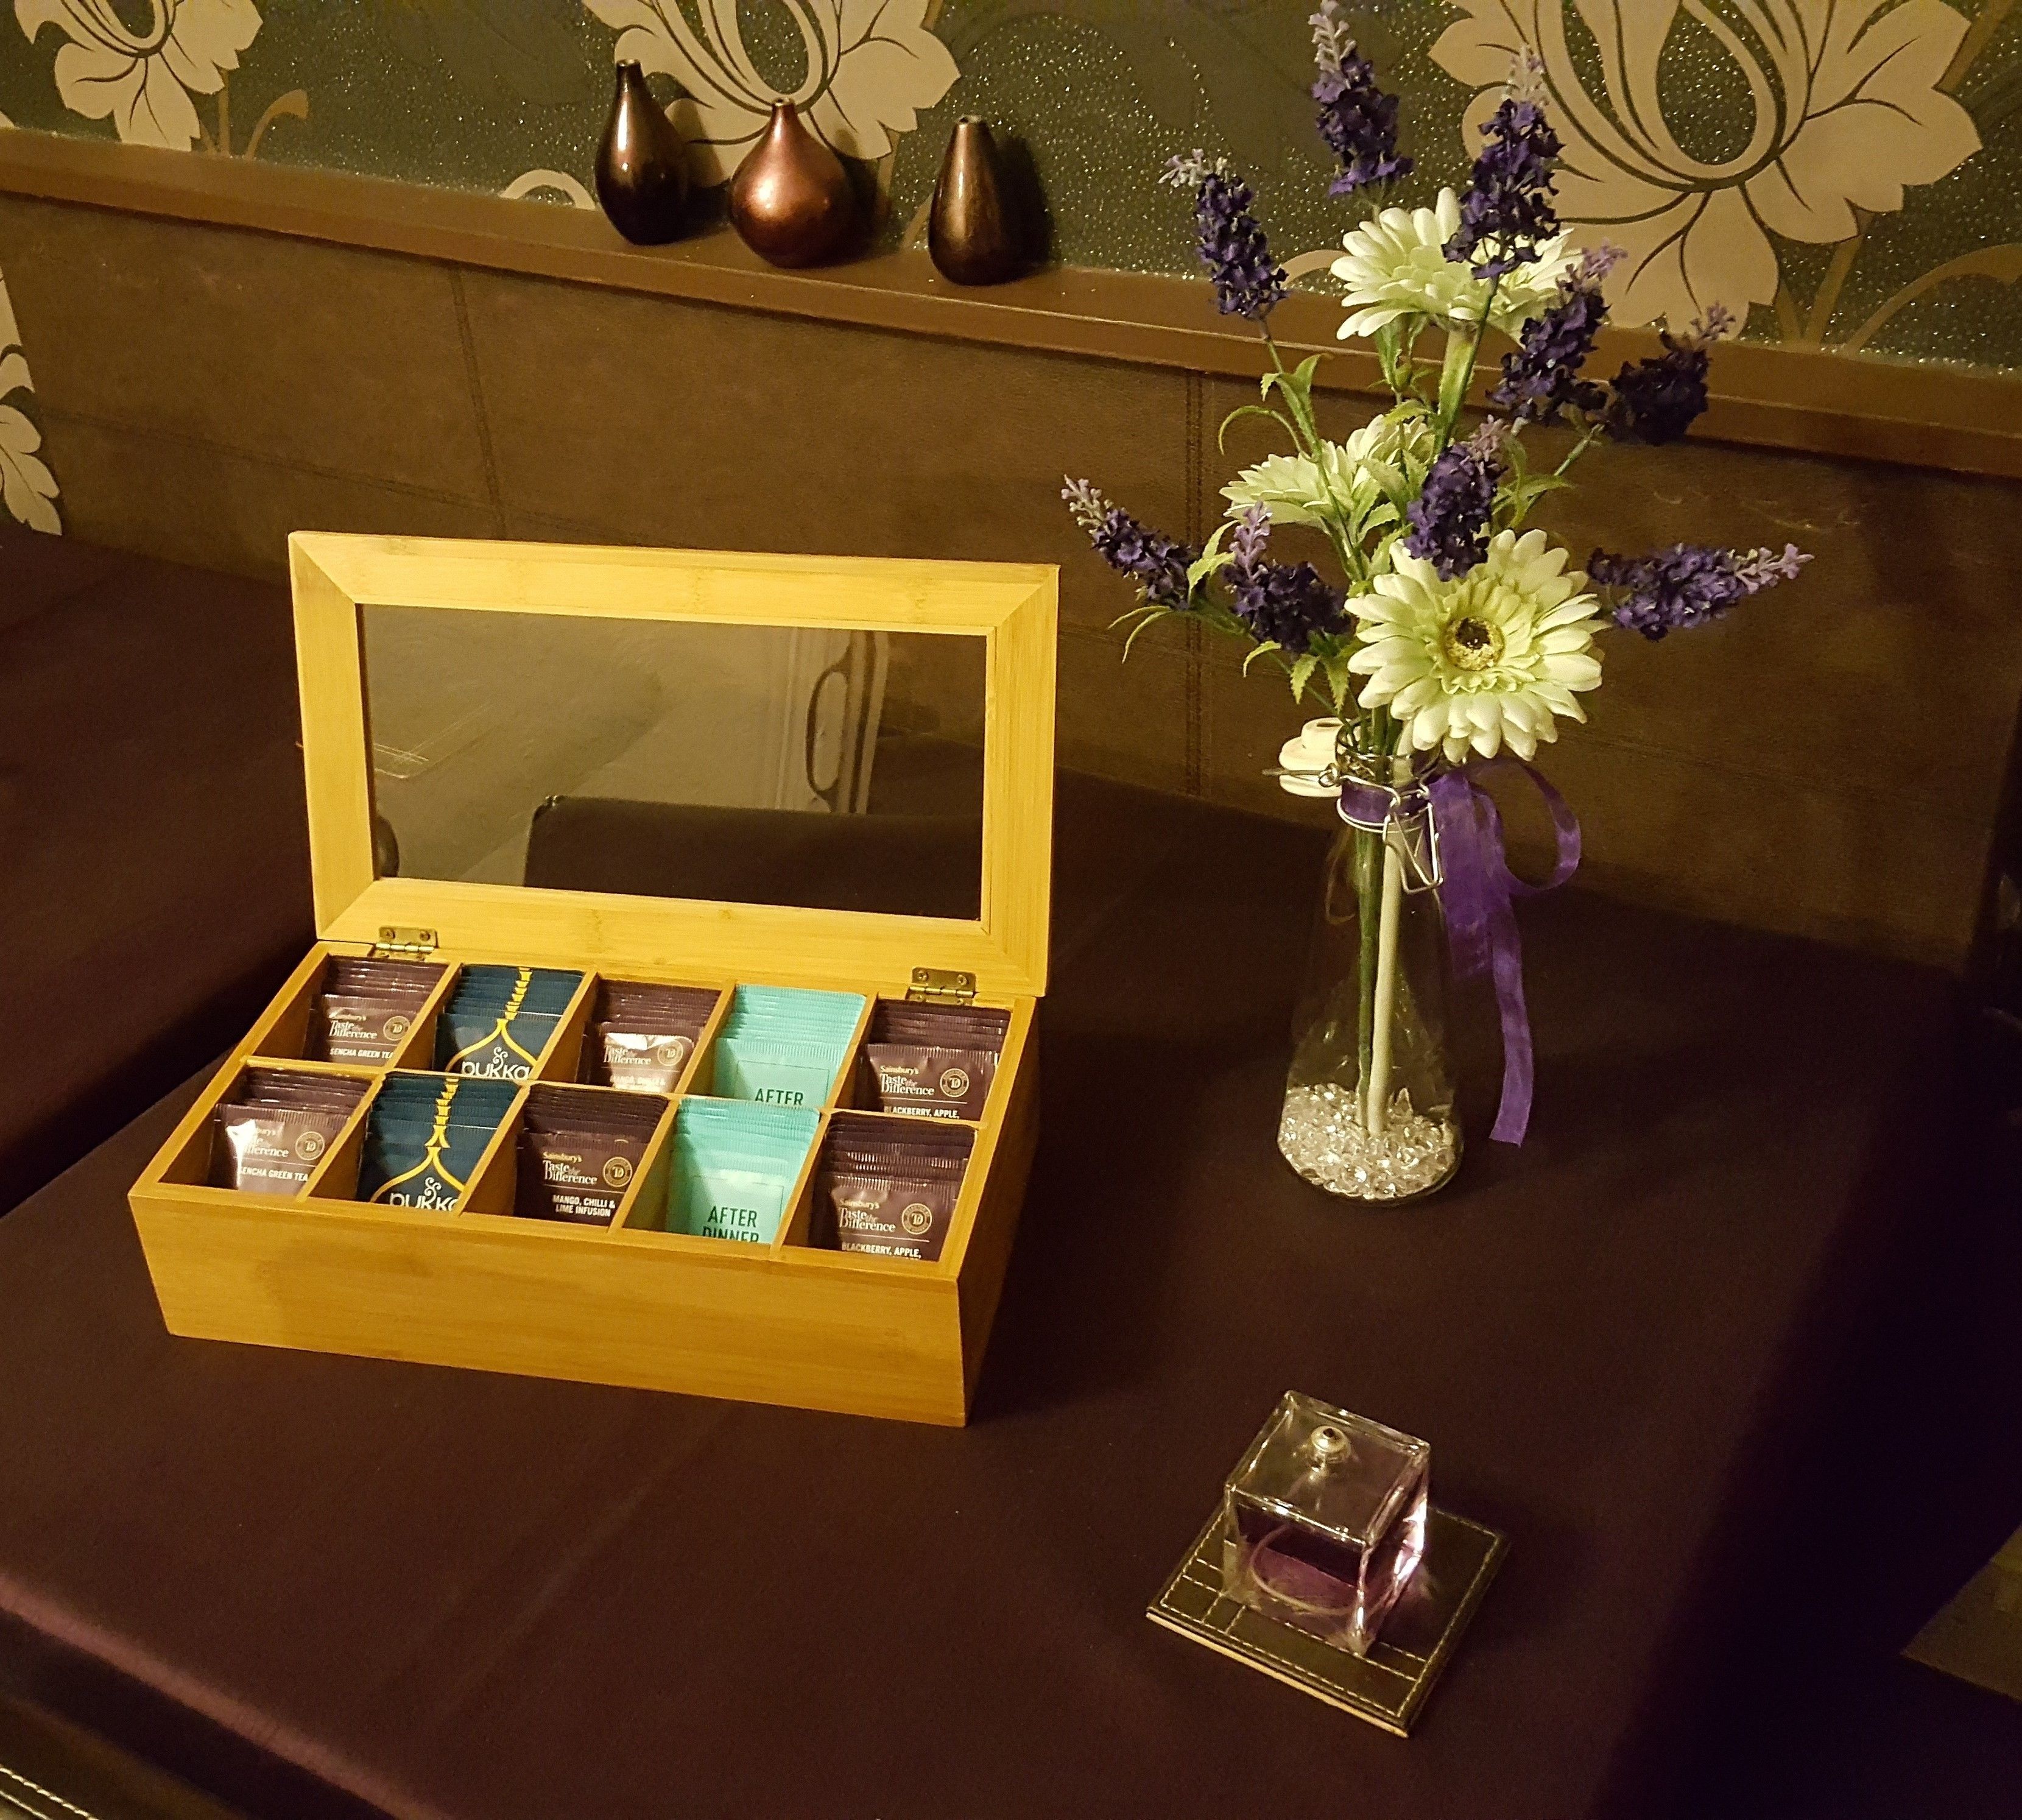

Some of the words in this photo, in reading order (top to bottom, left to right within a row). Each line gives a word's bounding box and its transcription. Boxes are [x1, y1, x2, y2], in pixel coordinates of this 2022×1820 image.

[329, 1027, 378, 1039] Difference
[329, 1048, 356, 1057] SENCHA
[357, 1049, 380, 1059] GREEN
[880, 1065, 920, 1076] Sainsbury's
[880, 1073, 907, 1084] Taste
[881, 1082, 935, 1096] Difference
[755, 1088, 805, 1106] AFTER
[934, 1109, 960, 1120] APPLE,
[543, 1152, 582, 1163] Sainsbury's
[543, 1160, 570, 1172] Taste
[268, 1169, 292, 1180] GREEN
[294, 1173, 309, 1182] TEA
[544, 1170, 597, 1185] Difference
[552, 1194, 582, 1206] MANGO,
[583, 1197, 608, 1208] CHILLI
[608, 1199, 616, 1208] &
[840, 1198, 880, 1210] Sainsbury's
[555, 1204, 574, 1214] LIME
[575, 1206, 611, 1217] INFUSION
[707, 1205, 758, 1228] AFTER
[838, 1207, 867, 1219] Taste
[839, 1217, 896, 1233] Difference
[842, 1241, 892, 1256] BLACKBERRY,
[893, 1246, 922, 1260] APPLE,
